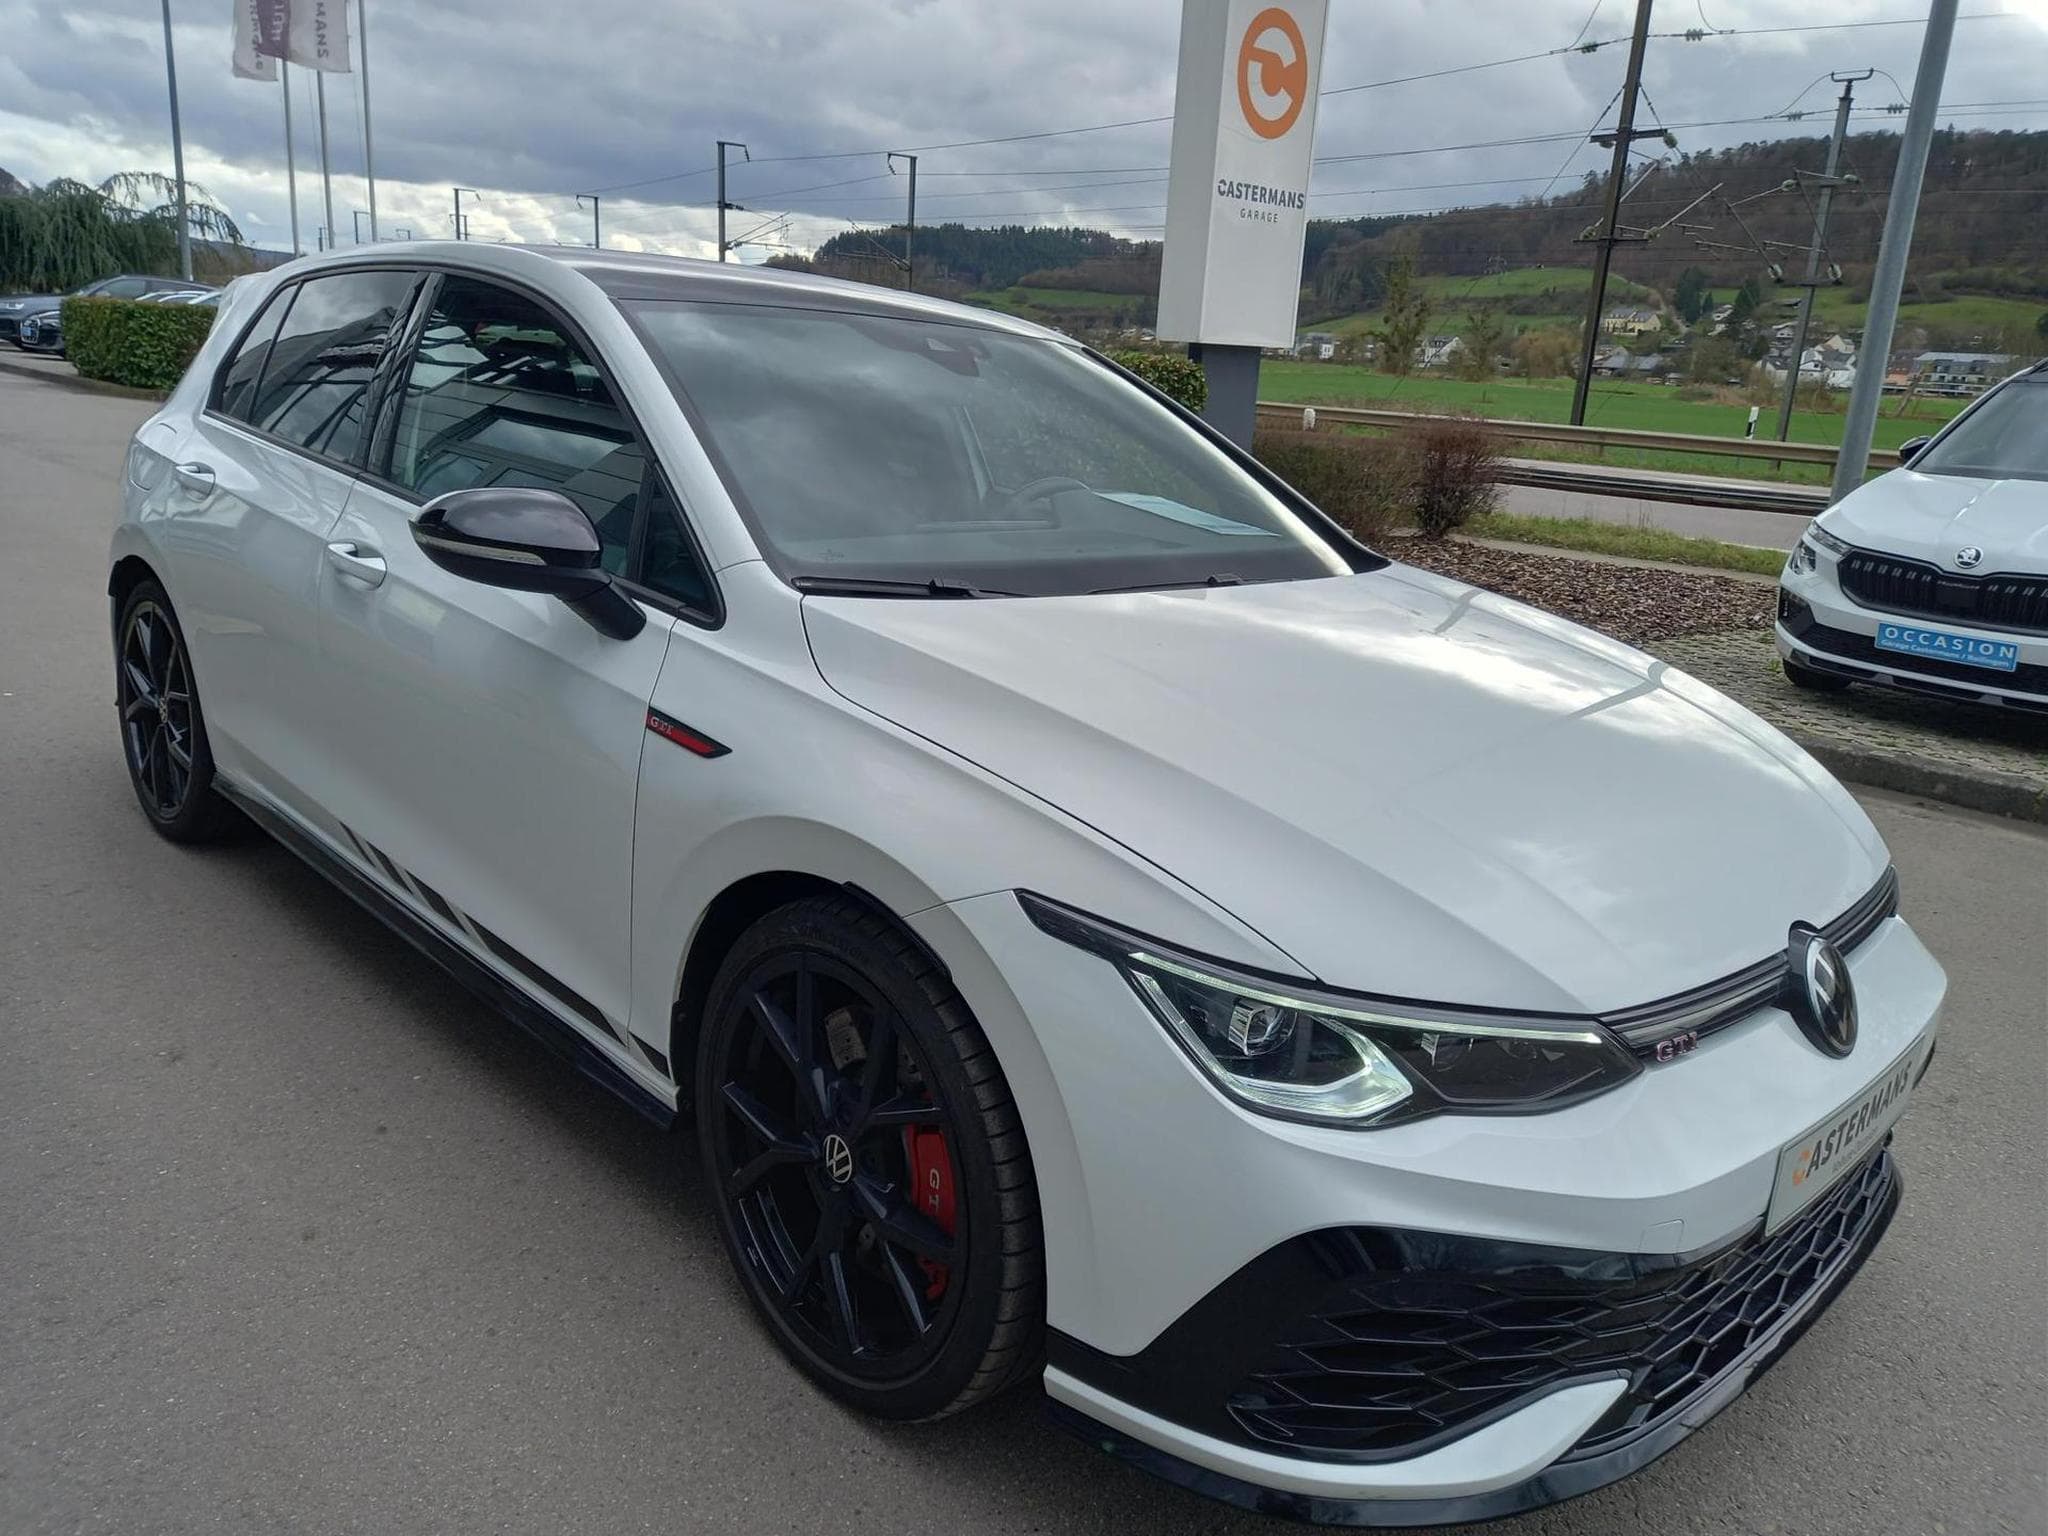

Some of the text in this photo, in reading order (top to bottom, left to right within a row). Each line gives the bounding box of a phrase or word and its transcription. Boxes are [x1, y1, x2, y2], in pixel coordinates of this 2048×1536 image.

[1217, 178, 1305, 209] CASTERMANS
[1240, 208, 1279, 223] GARAGE
[1885, 627, 2015, 659] OCCASION
[1656, 1031, 1698, 1062] GTI
